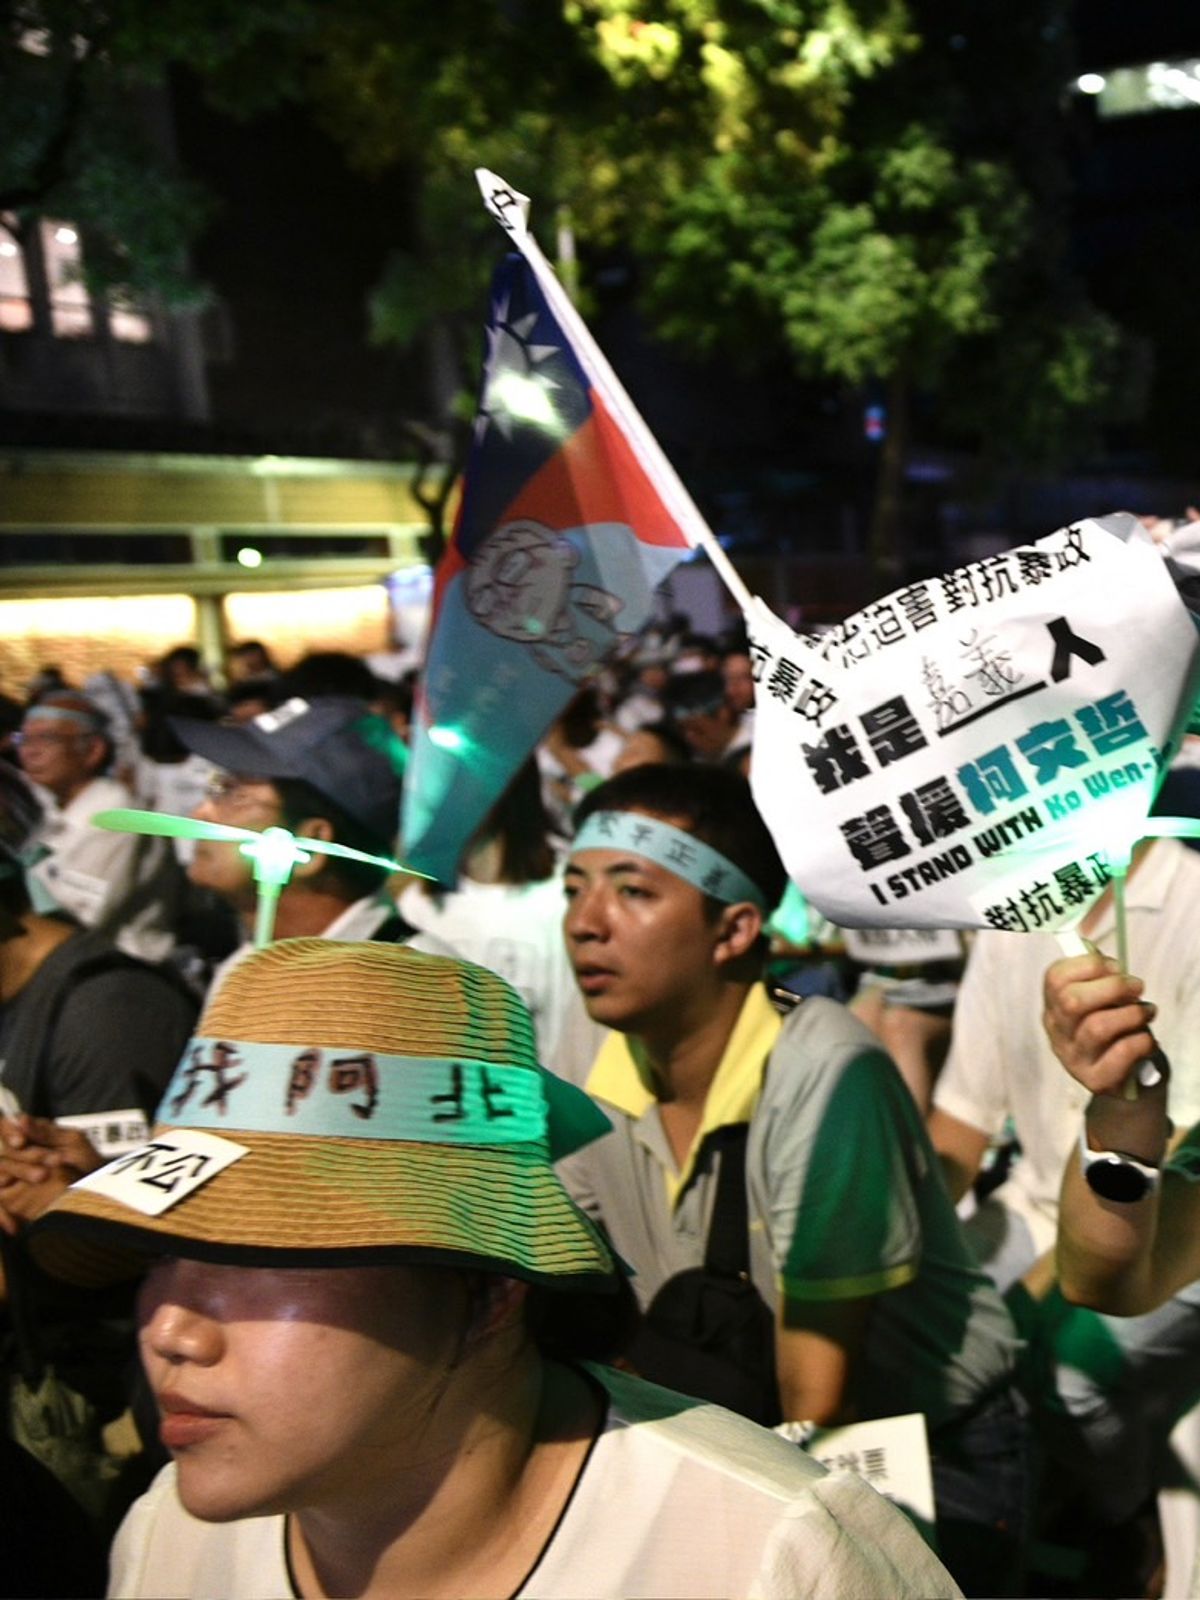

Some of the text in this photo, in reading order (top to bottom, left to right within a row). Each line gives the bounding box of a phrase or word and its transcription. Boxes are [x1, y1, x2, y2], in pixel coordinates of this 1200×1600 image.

[800, 694, 928, 795] 我是
[1046, 616, 1106, 684] 人
[838, 688, 1149, 873] 聲援柯文哲
[869, 883, 888, 906] I
[894, 843, 972, 899] STAND
[982, 805, 1044, 859] WITH
[1048, 789, 1081, 821] Ko
[110, 1142, 213, 1195] 不公
